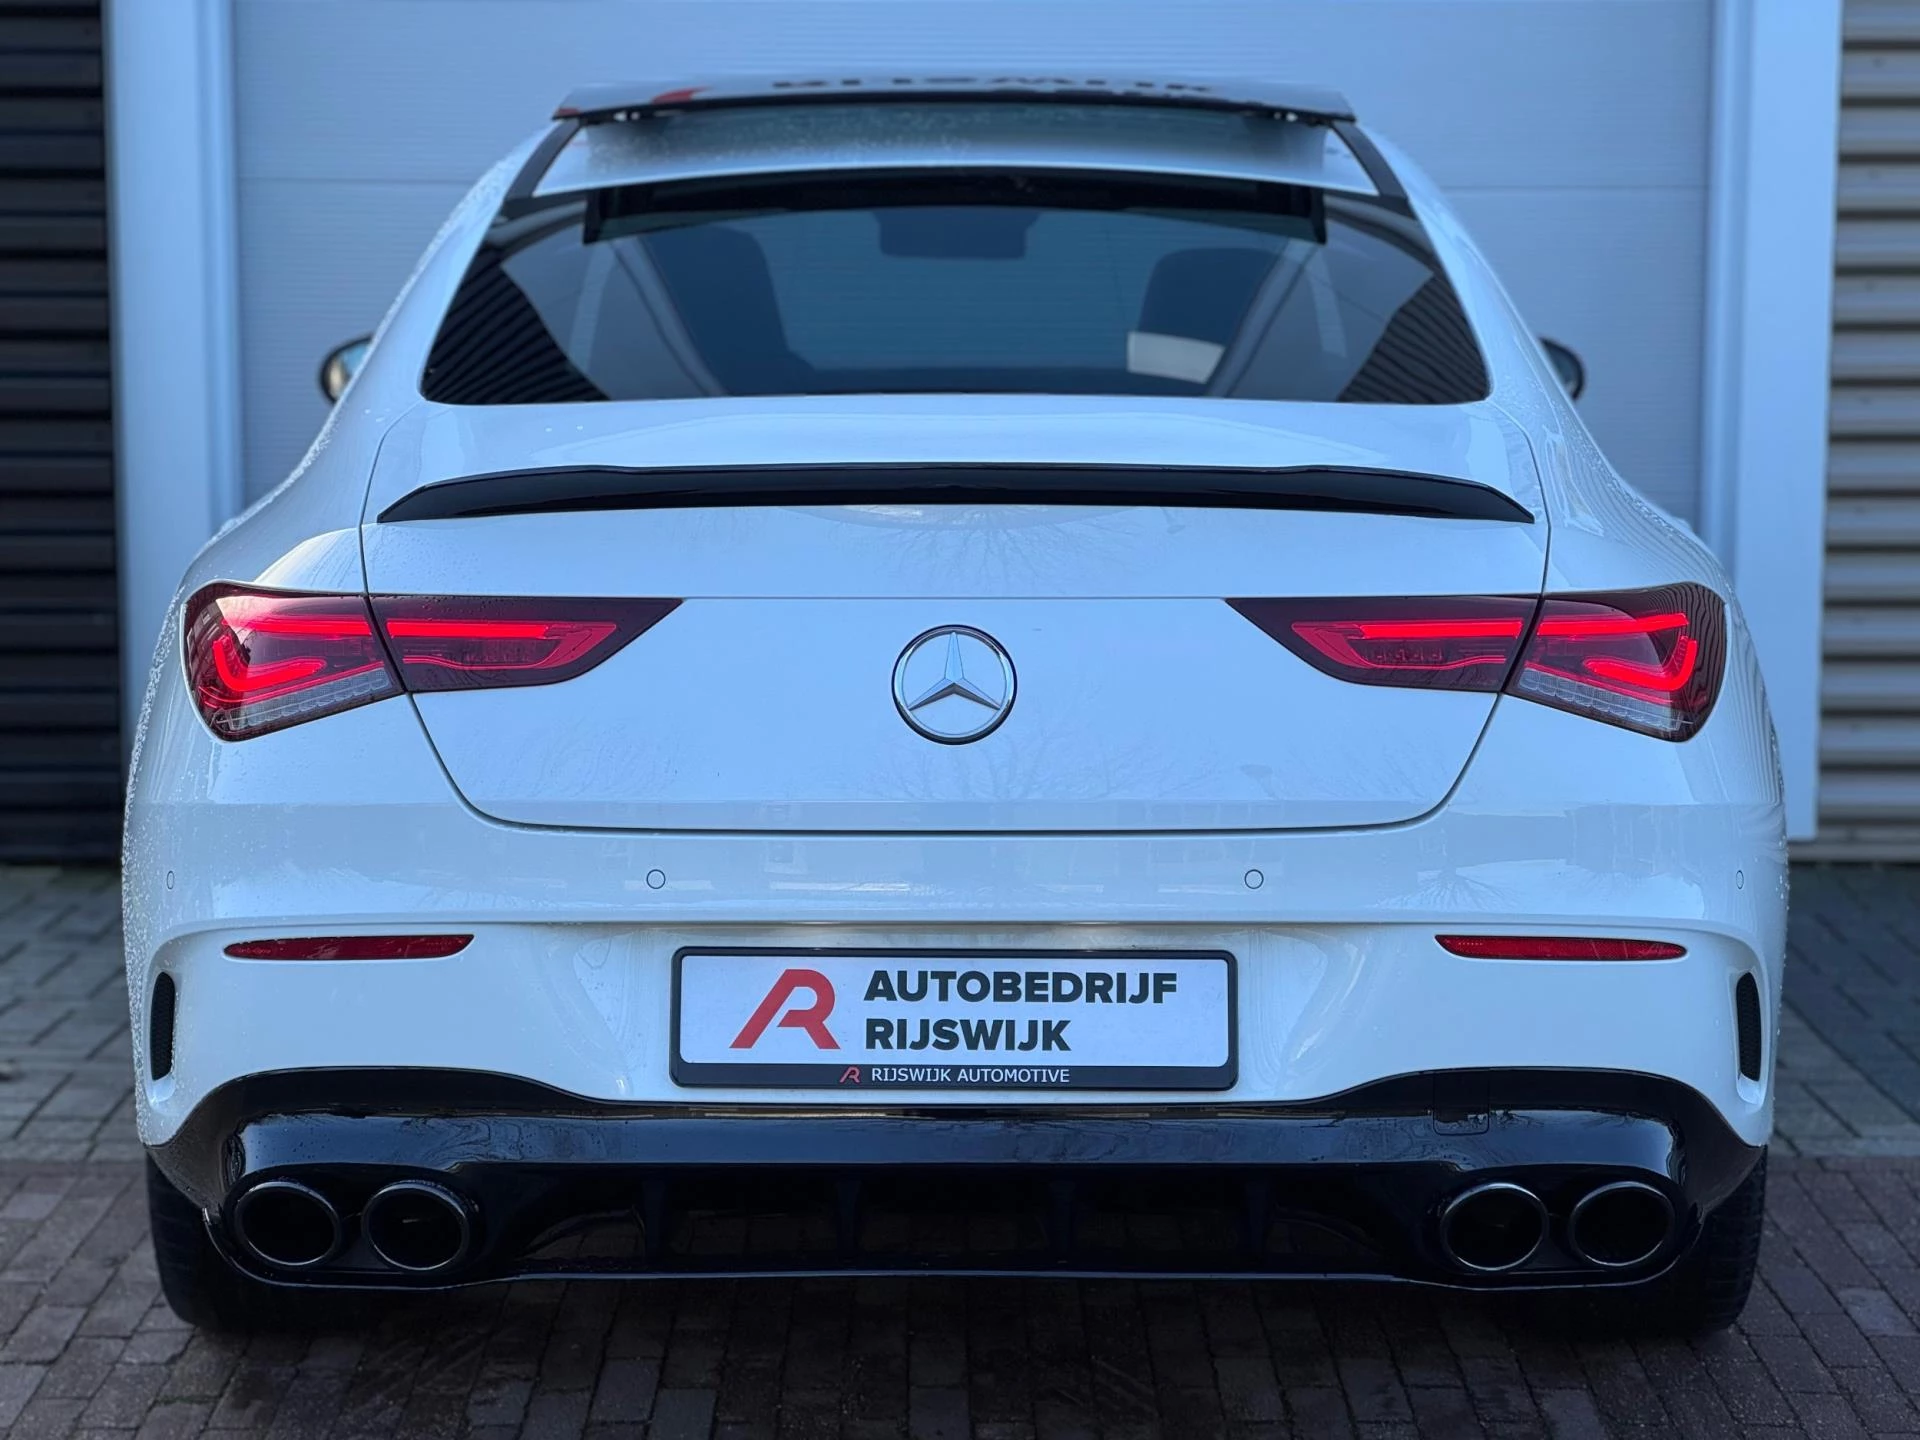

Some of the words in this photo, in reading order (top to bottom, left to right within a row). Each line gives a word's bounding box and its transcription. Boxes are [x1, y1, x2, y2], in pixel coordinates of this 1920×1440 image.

[864, 970, 1177, 1005] AUTOBEDRIJF
[865, 1018, 1071, 1052] RIJSWIJK
[871, 1067, 952, 1083] RIJSWIJK
[956, 1068, 1071, 1083] AUTOMOTIVE
